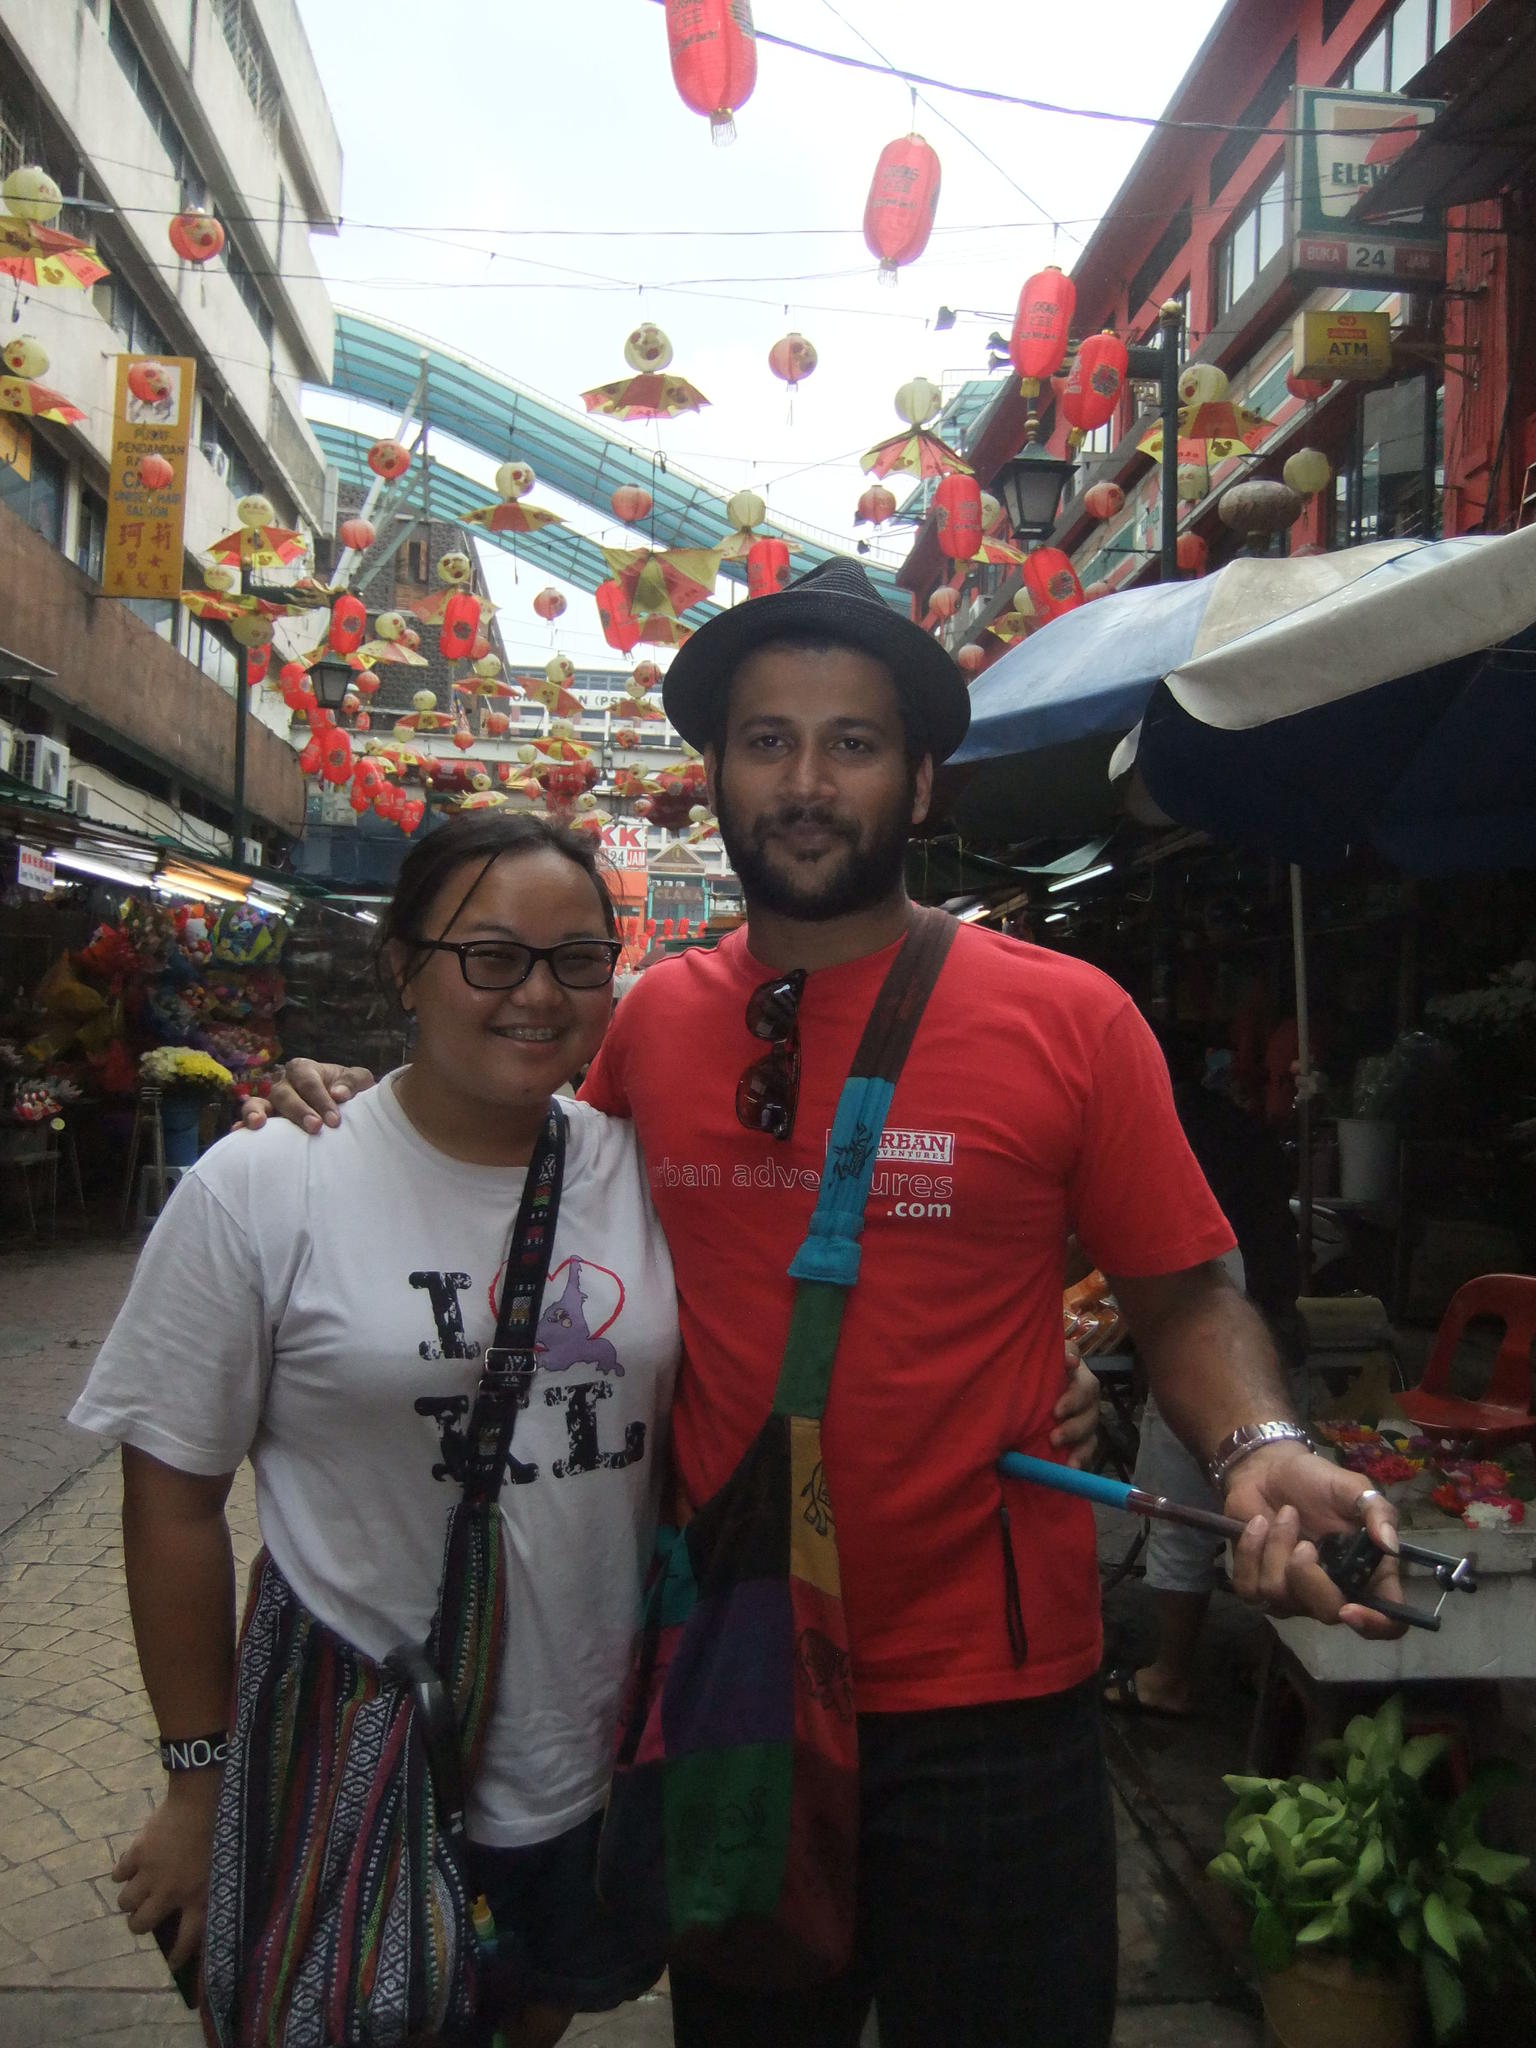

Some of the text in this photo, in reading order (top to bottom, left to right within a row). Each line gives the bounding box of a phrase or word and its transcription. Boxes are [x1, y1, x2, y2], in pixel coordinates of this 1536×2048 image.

[1355, 247, 1386, 268] 24
[1329, 342, 1368, 355] ATM
[610, 850, 624, 865] 24
[627, 851, 646, 865] JAM
[879, 1132, 949, 1153] RBAN
[877, 1148, 946, 1160] VENTURES
[886, 1202, 951, 1217] .com
[408, 1271, 481, 1361] I
[414, 1380, 647, 1485] KL
